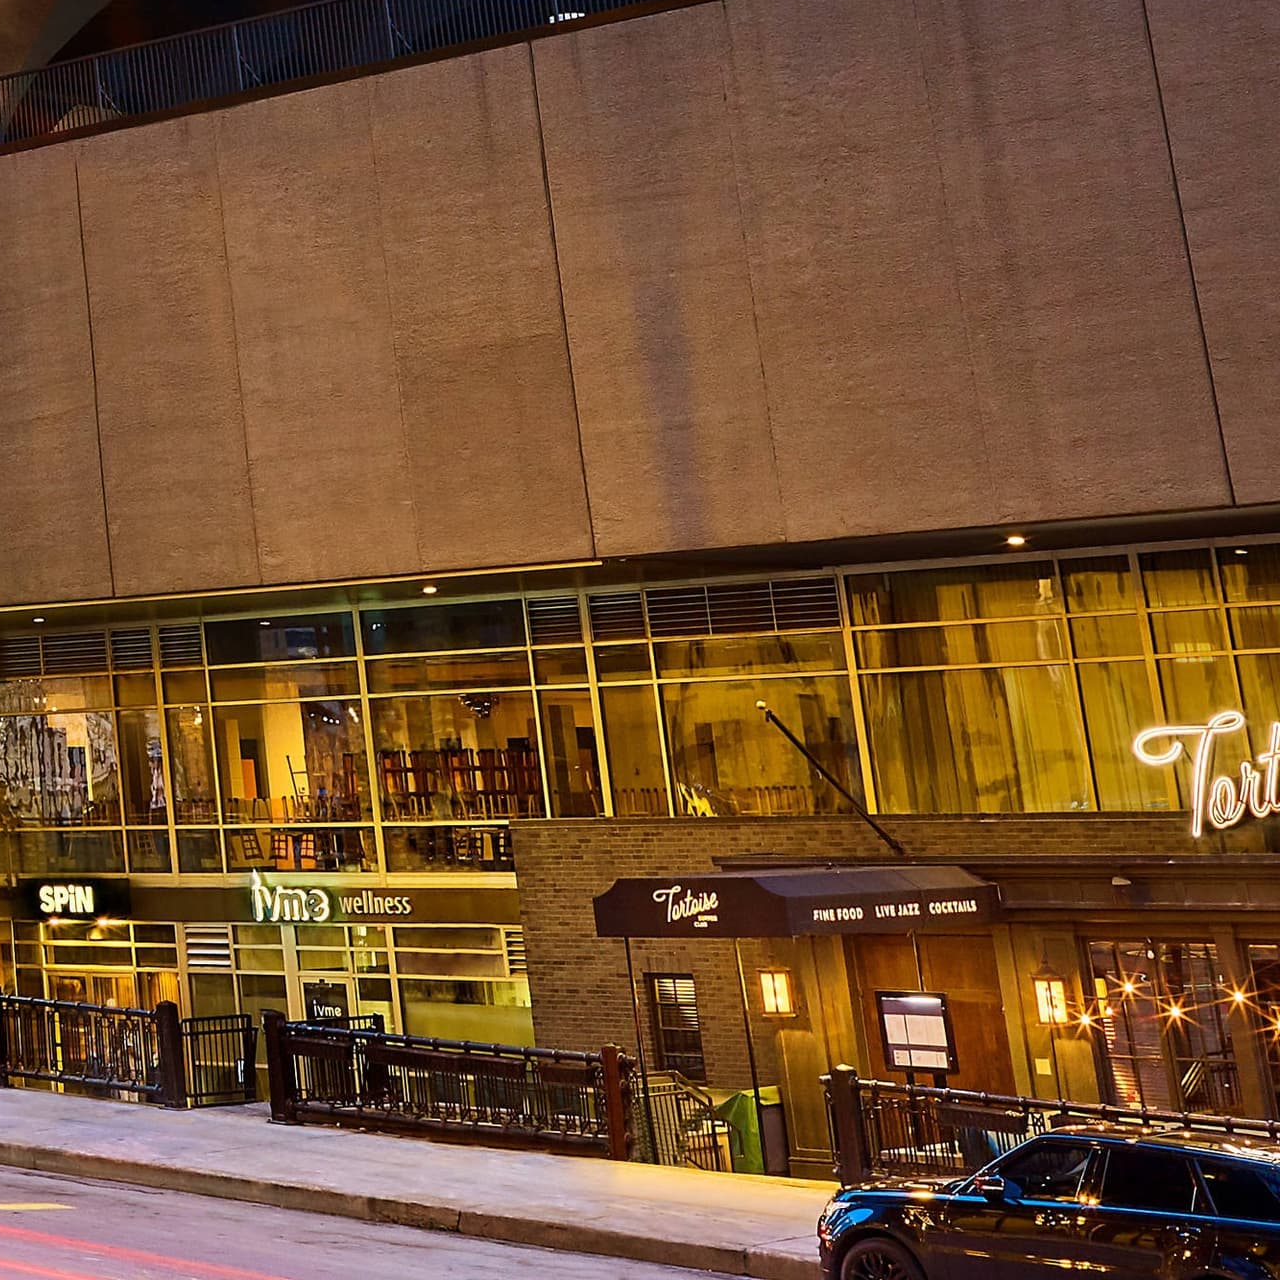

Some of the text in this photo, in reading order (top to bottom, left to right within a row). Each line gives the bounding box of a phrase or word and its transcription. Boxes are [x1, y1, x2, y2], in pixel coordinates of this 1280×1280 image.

[339, 889, 412, 915] wellness
[653, 885, 719, 923] Tortoise
[813, 900, 977, 922] FINE FOOD LIVE JAZZ COCKTAILS
[313, 999, 342, 1017] ivme
